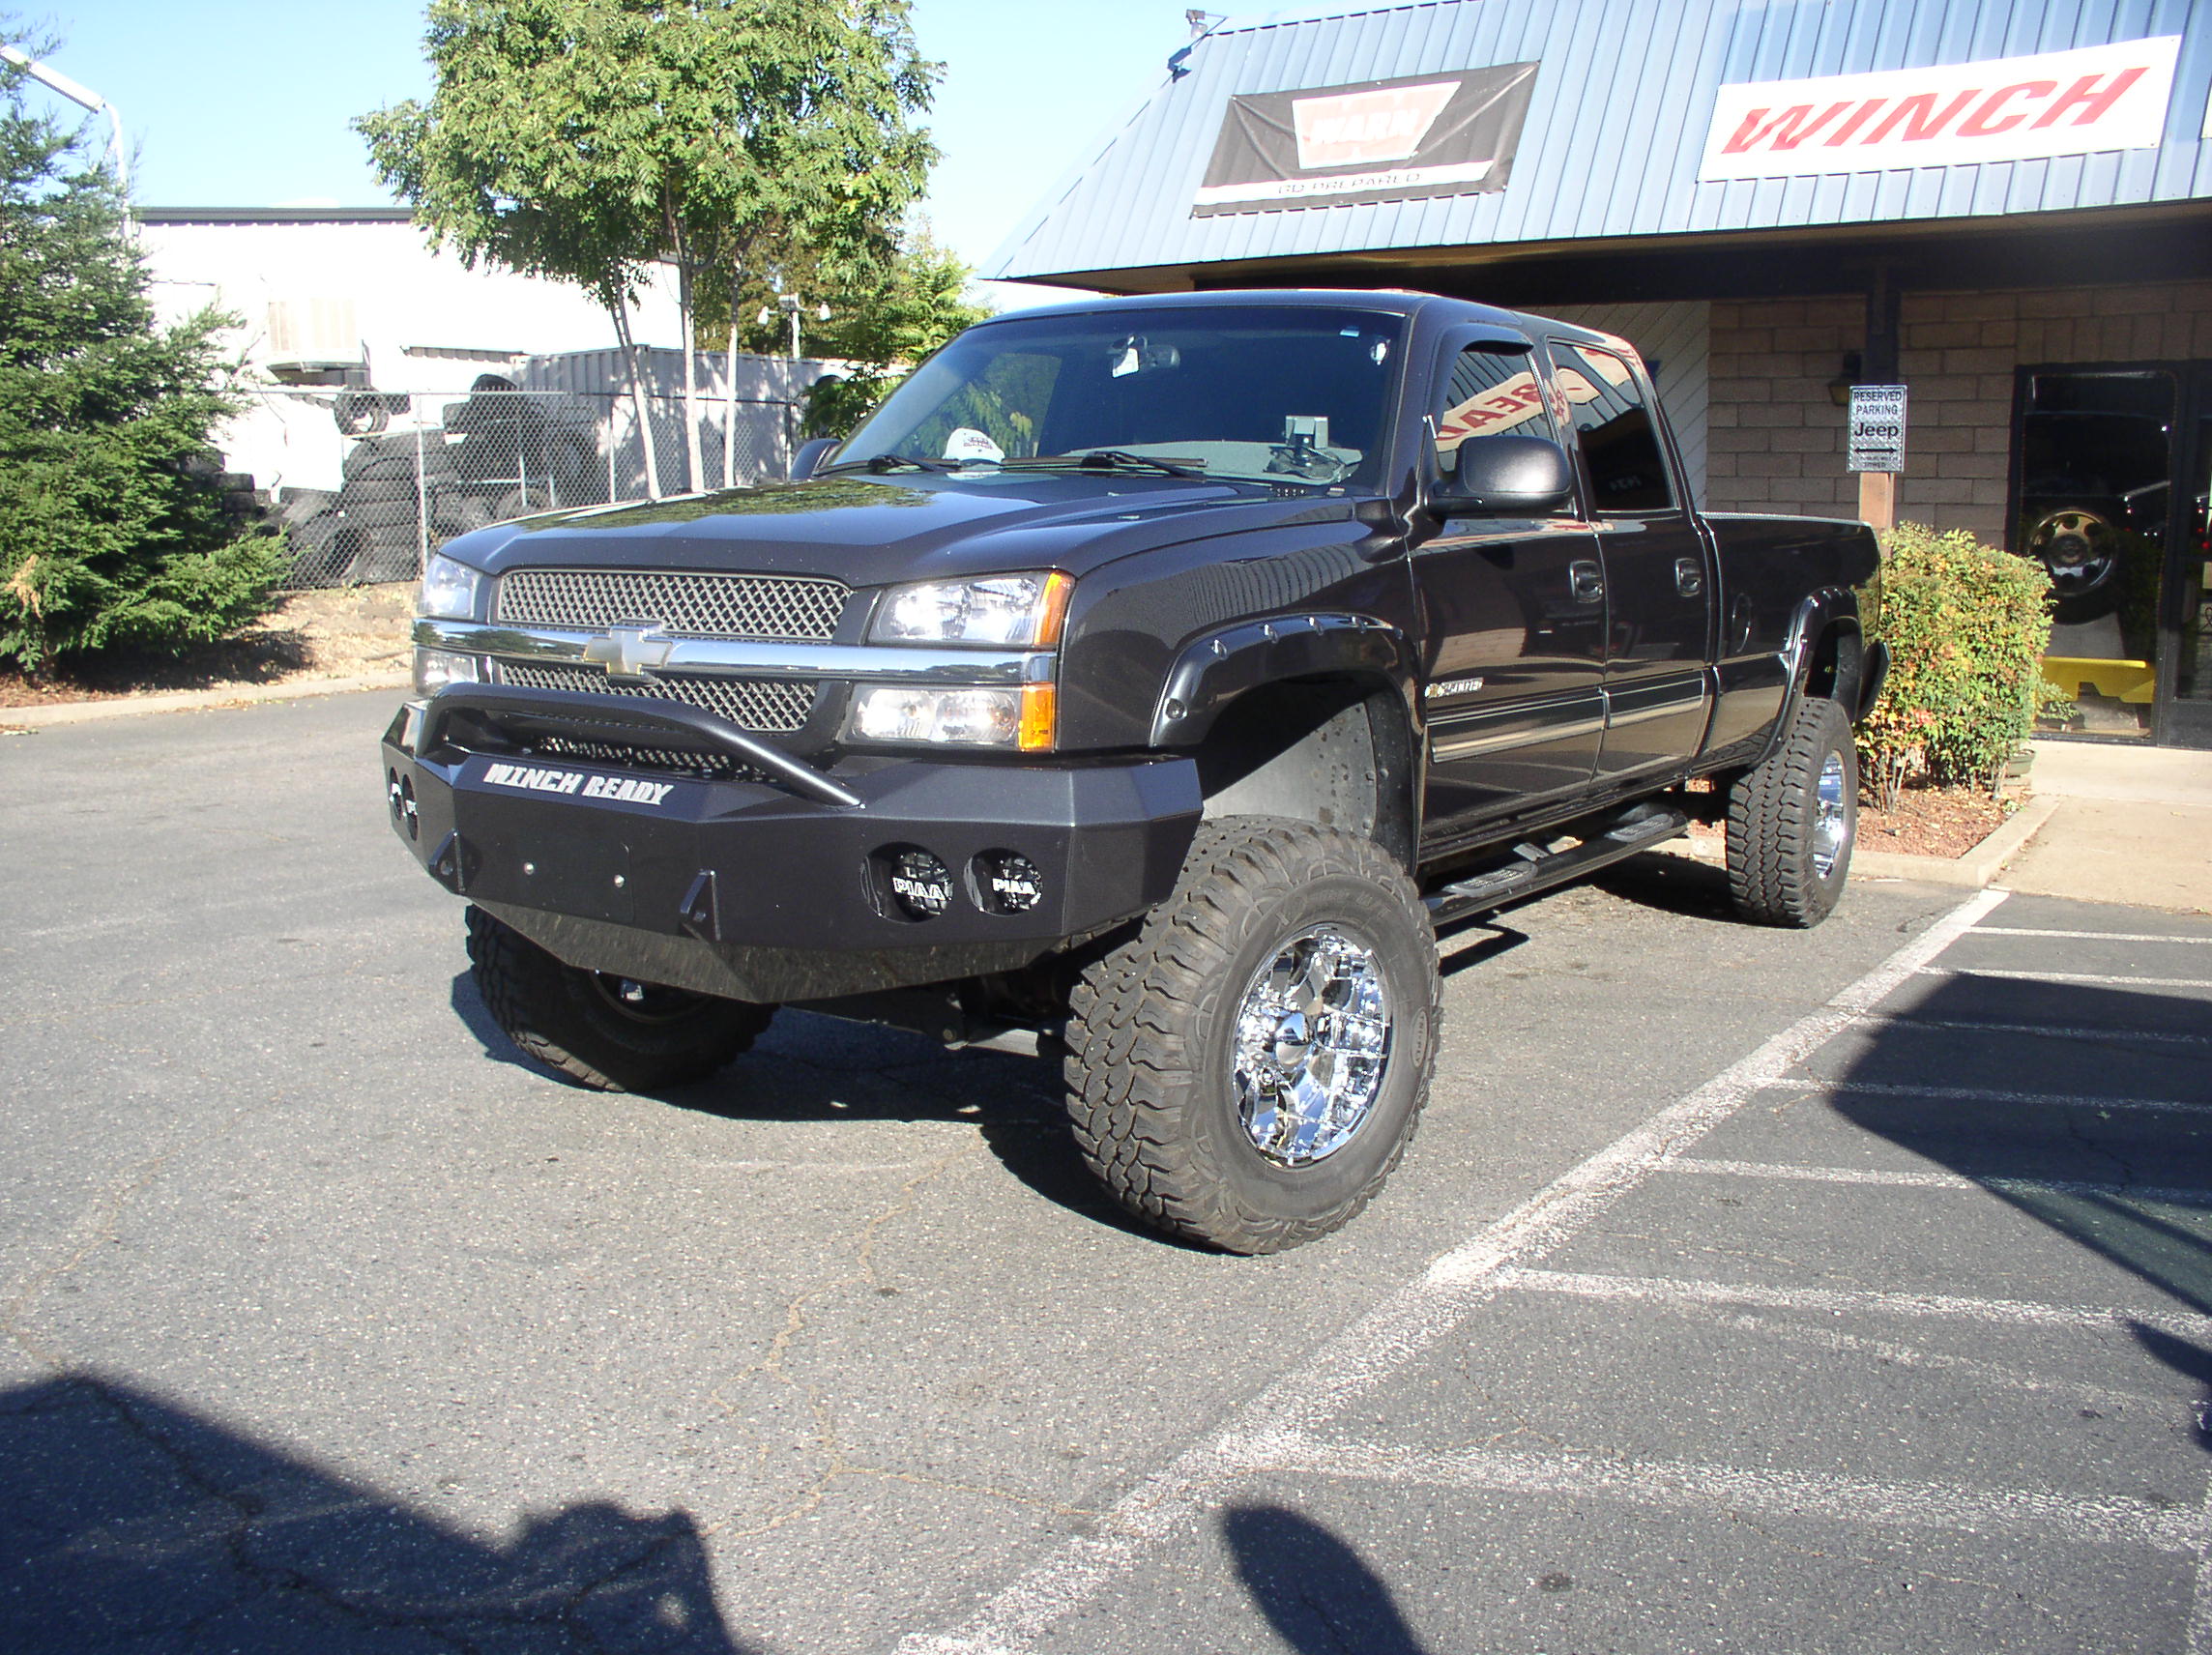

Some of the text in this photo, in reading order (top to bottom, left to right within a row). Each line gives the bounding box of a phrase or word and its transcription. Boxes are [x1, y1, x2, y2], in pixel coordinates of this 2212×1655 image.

[1721, 67, 2150, 155] WINCH
[1312, 109, 1419, 145] WARN
[1312, 173, 1421, 189] PREPARED
[1853, 391, 1903, 402] RESERVED
[1856, 404, 1898, 416] PARKING
[1854, 422, 1899, 439] Jeep
[483, 763, 675, 805] WINCH READY
[892, 877, 946, 901] PIAA
[992, 878, 1036, 895] PIAA
